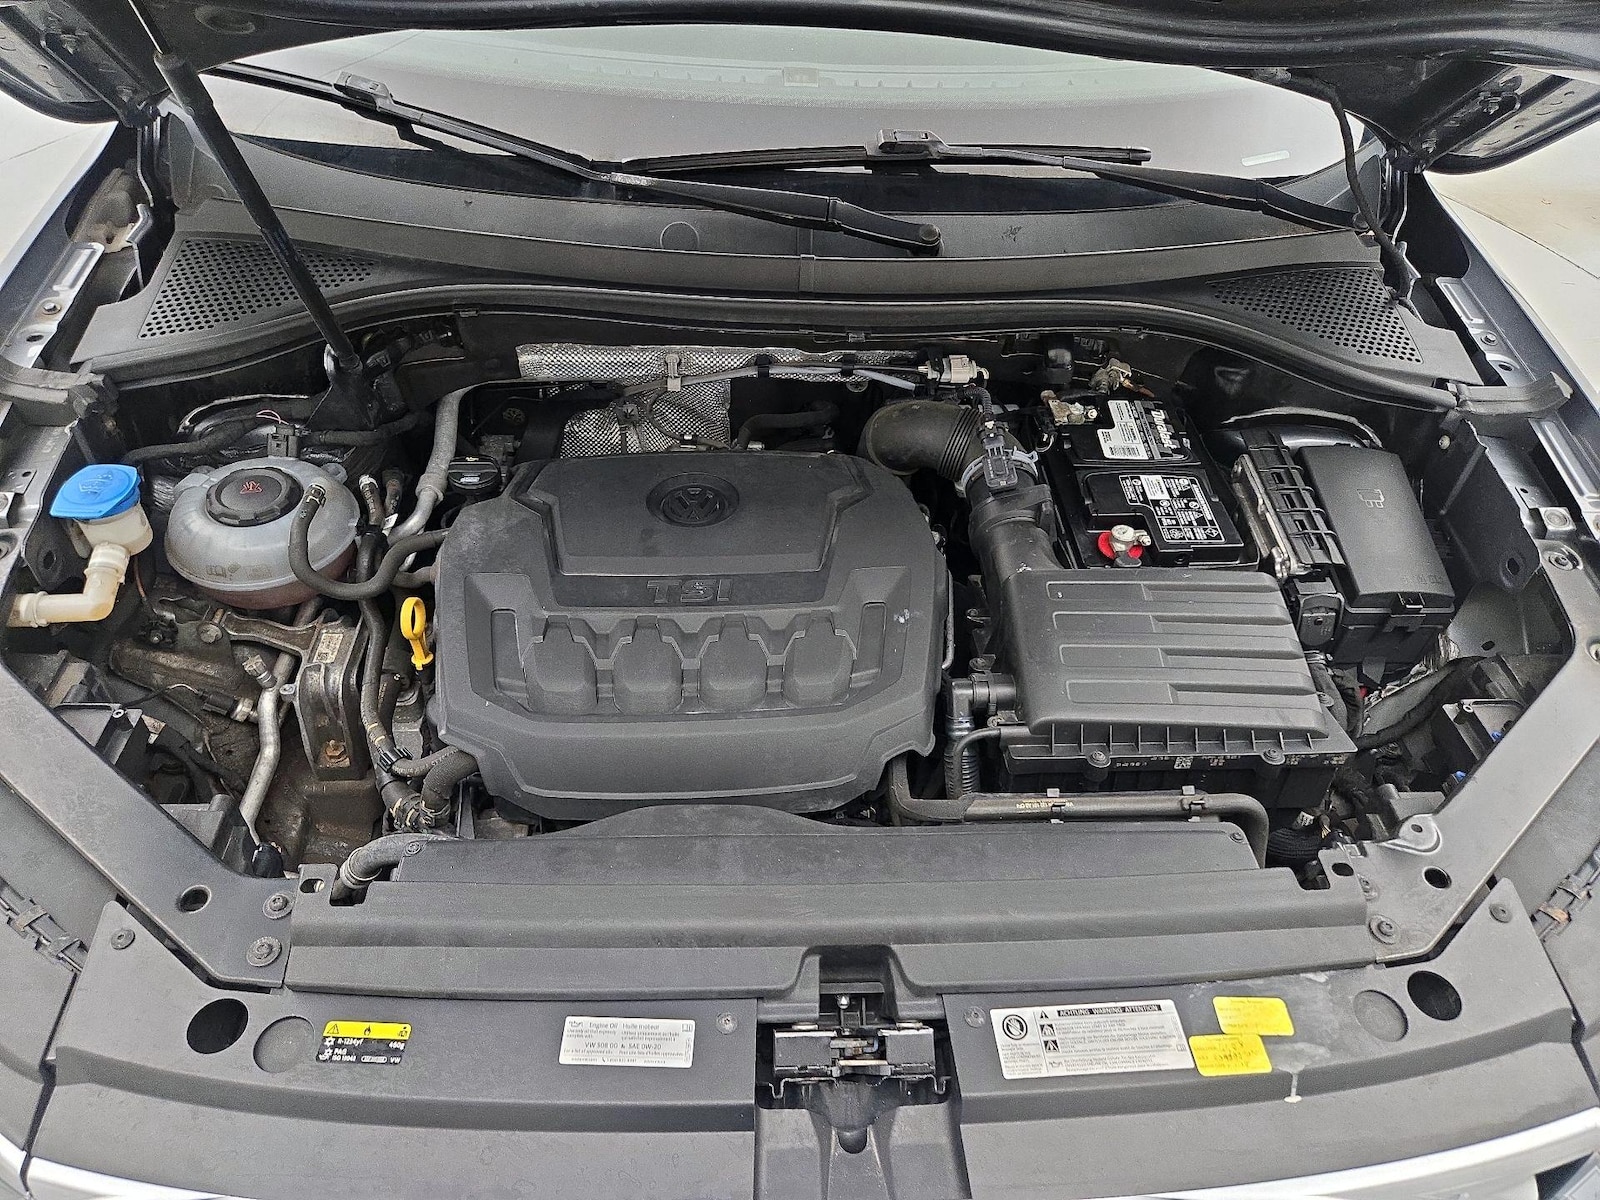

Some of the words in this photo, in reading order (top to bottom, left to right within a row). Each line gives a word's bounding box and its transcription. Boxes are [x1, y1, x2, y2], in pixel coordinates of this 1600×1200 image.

[1150, 409, 1178, 450] Duralast
[646, 579, 733, 604] TSI
[1059, 1008, 1089, 1017] ACHTUNG
[1092, 1006, 1122, 1015] WARNING
[1124, 1004, 1158, 1013] ATTENTION
[589, 1022, 609, 1030] Engine
[622, 1022, 639, 1030] Huile
[390, 1056, 401, 1064] VW
